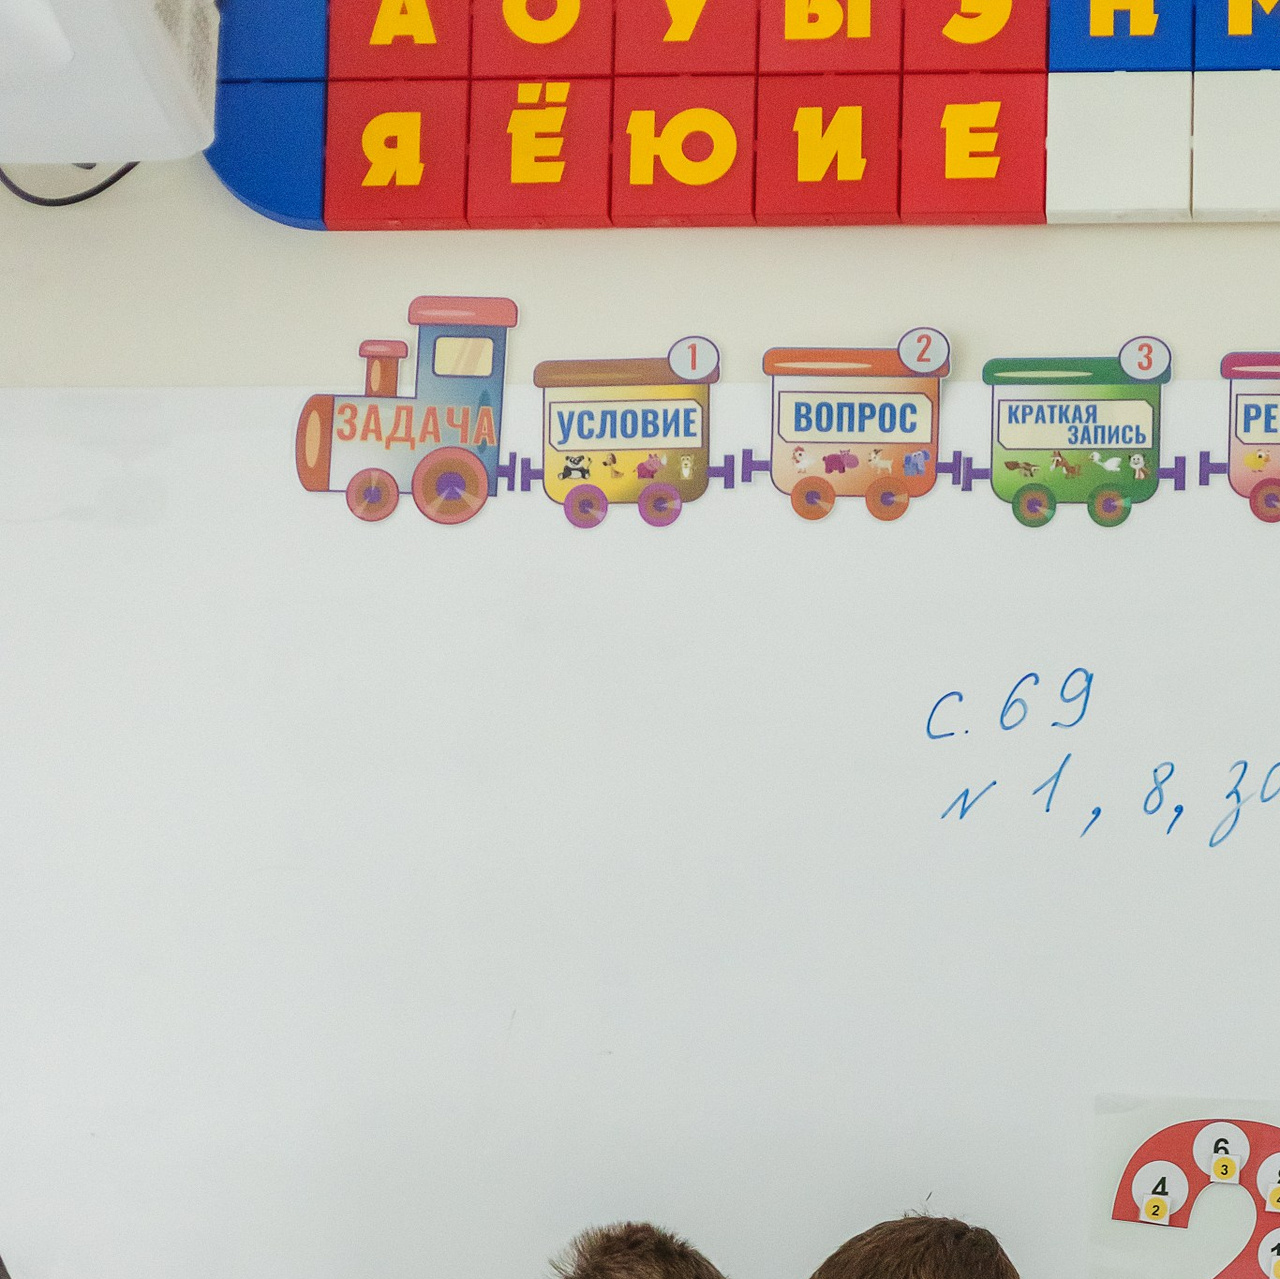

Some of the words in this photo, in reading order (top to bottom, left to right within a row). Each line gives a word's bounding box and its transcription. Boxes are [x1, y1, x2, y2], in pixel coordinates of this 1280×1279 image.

[361, 111, 425, 186] Я
[507, 82, 571, 184] Ё
[626, 107, 738, 185] Ю
[793, 105, 867, 182] И
[940, 101, 1001, 179] Е
[687, 343, 697, 370] 1
[916, 333, 932, 363] 2
[1137, 344, 1153, 371] 3
[336, 403, 499, 449] ЗАДАЧА
[556, 407, 698, 445] УСЛОВИЕ
[798, 401, 918, 433] ВОПРОС
[1007, 403, 1098, 426] КРАТКАЯ
[1067, 423, 1147, 446] ЗАПИСЬ
[999, 667, 1095, 731] 69
[1221, 1164, 1229, 1176] 3
[1152, 1204, 1160, 1217] 2
